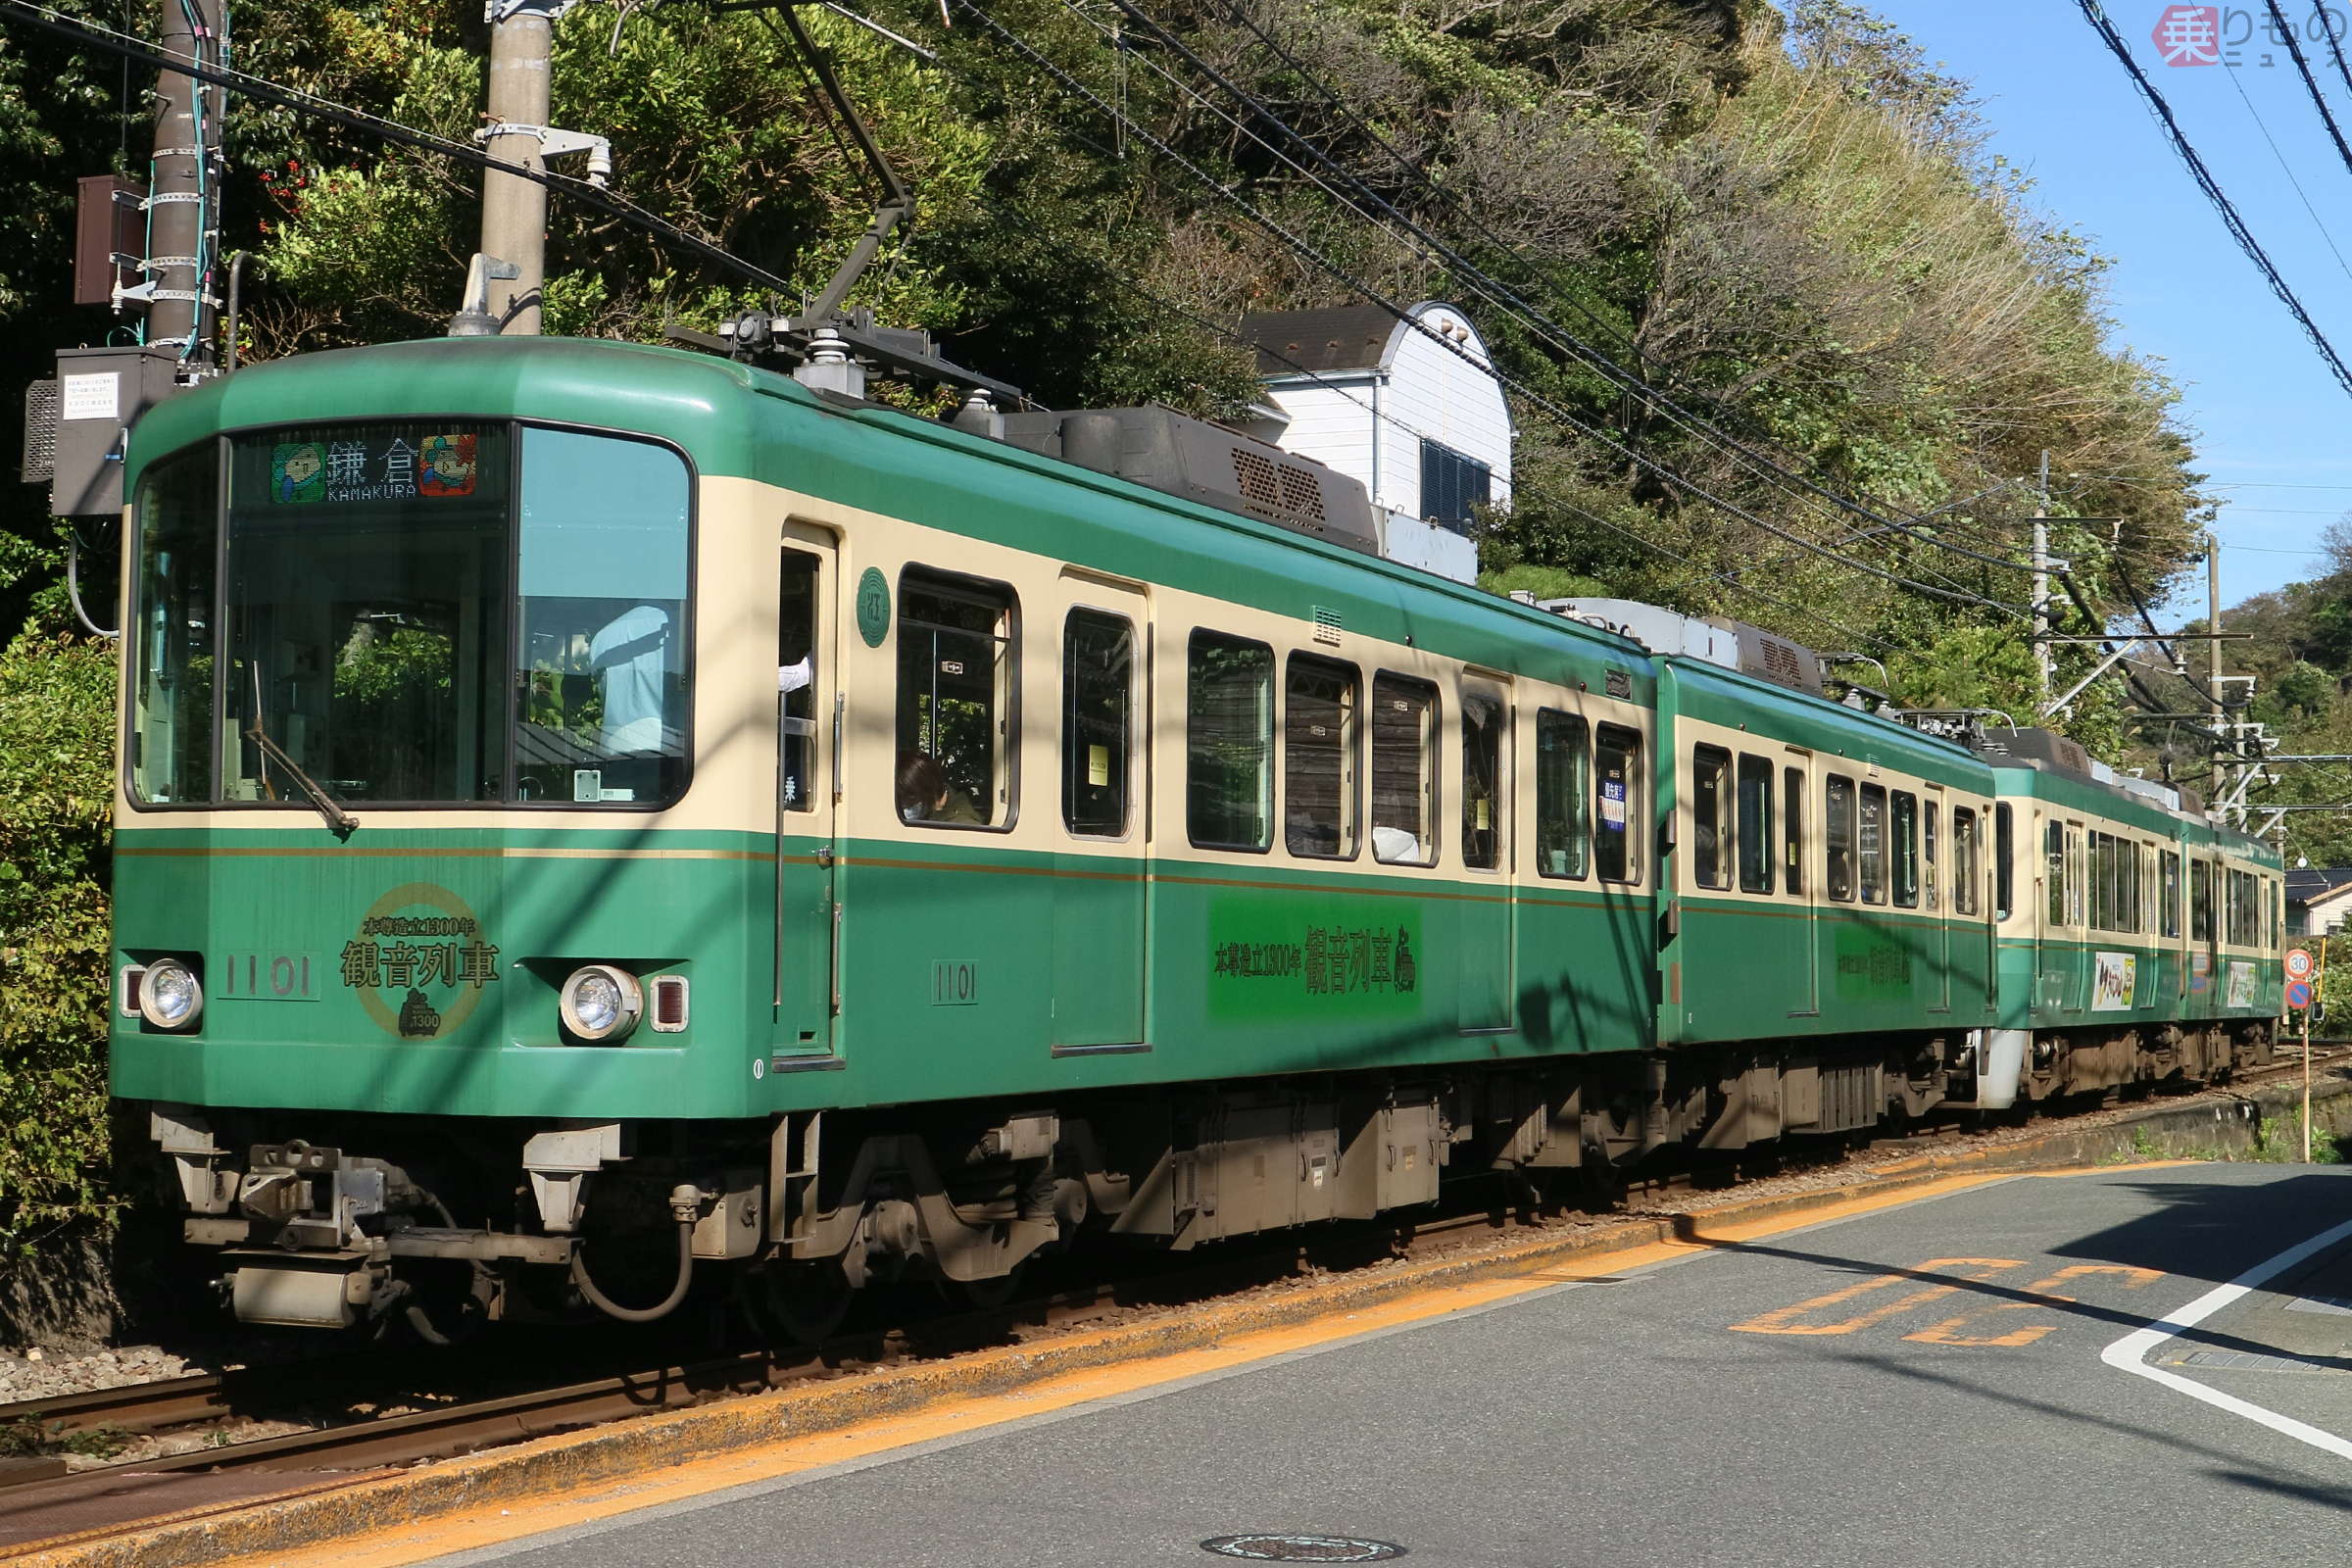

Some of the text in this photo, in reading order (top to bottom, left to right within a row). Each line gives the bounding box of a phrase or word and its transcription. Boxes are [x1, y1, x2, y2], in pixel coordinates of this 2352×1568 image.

[327, 437, 419, 485] 鎌倉
[328, 484, 416, 502] KAMAKURA
[363, 917, 476, 937] 本尊造立1300年
[226, 954, 310, 997] 1101
[340, 940, 500, 989] 観音列車
[1304, 924, 1393, 996] 観音列車
[2290, 956, 2308, 970] 30
[937, 963, 976, 1002] 1101
[412, 1014, 440, 1028] 1300
